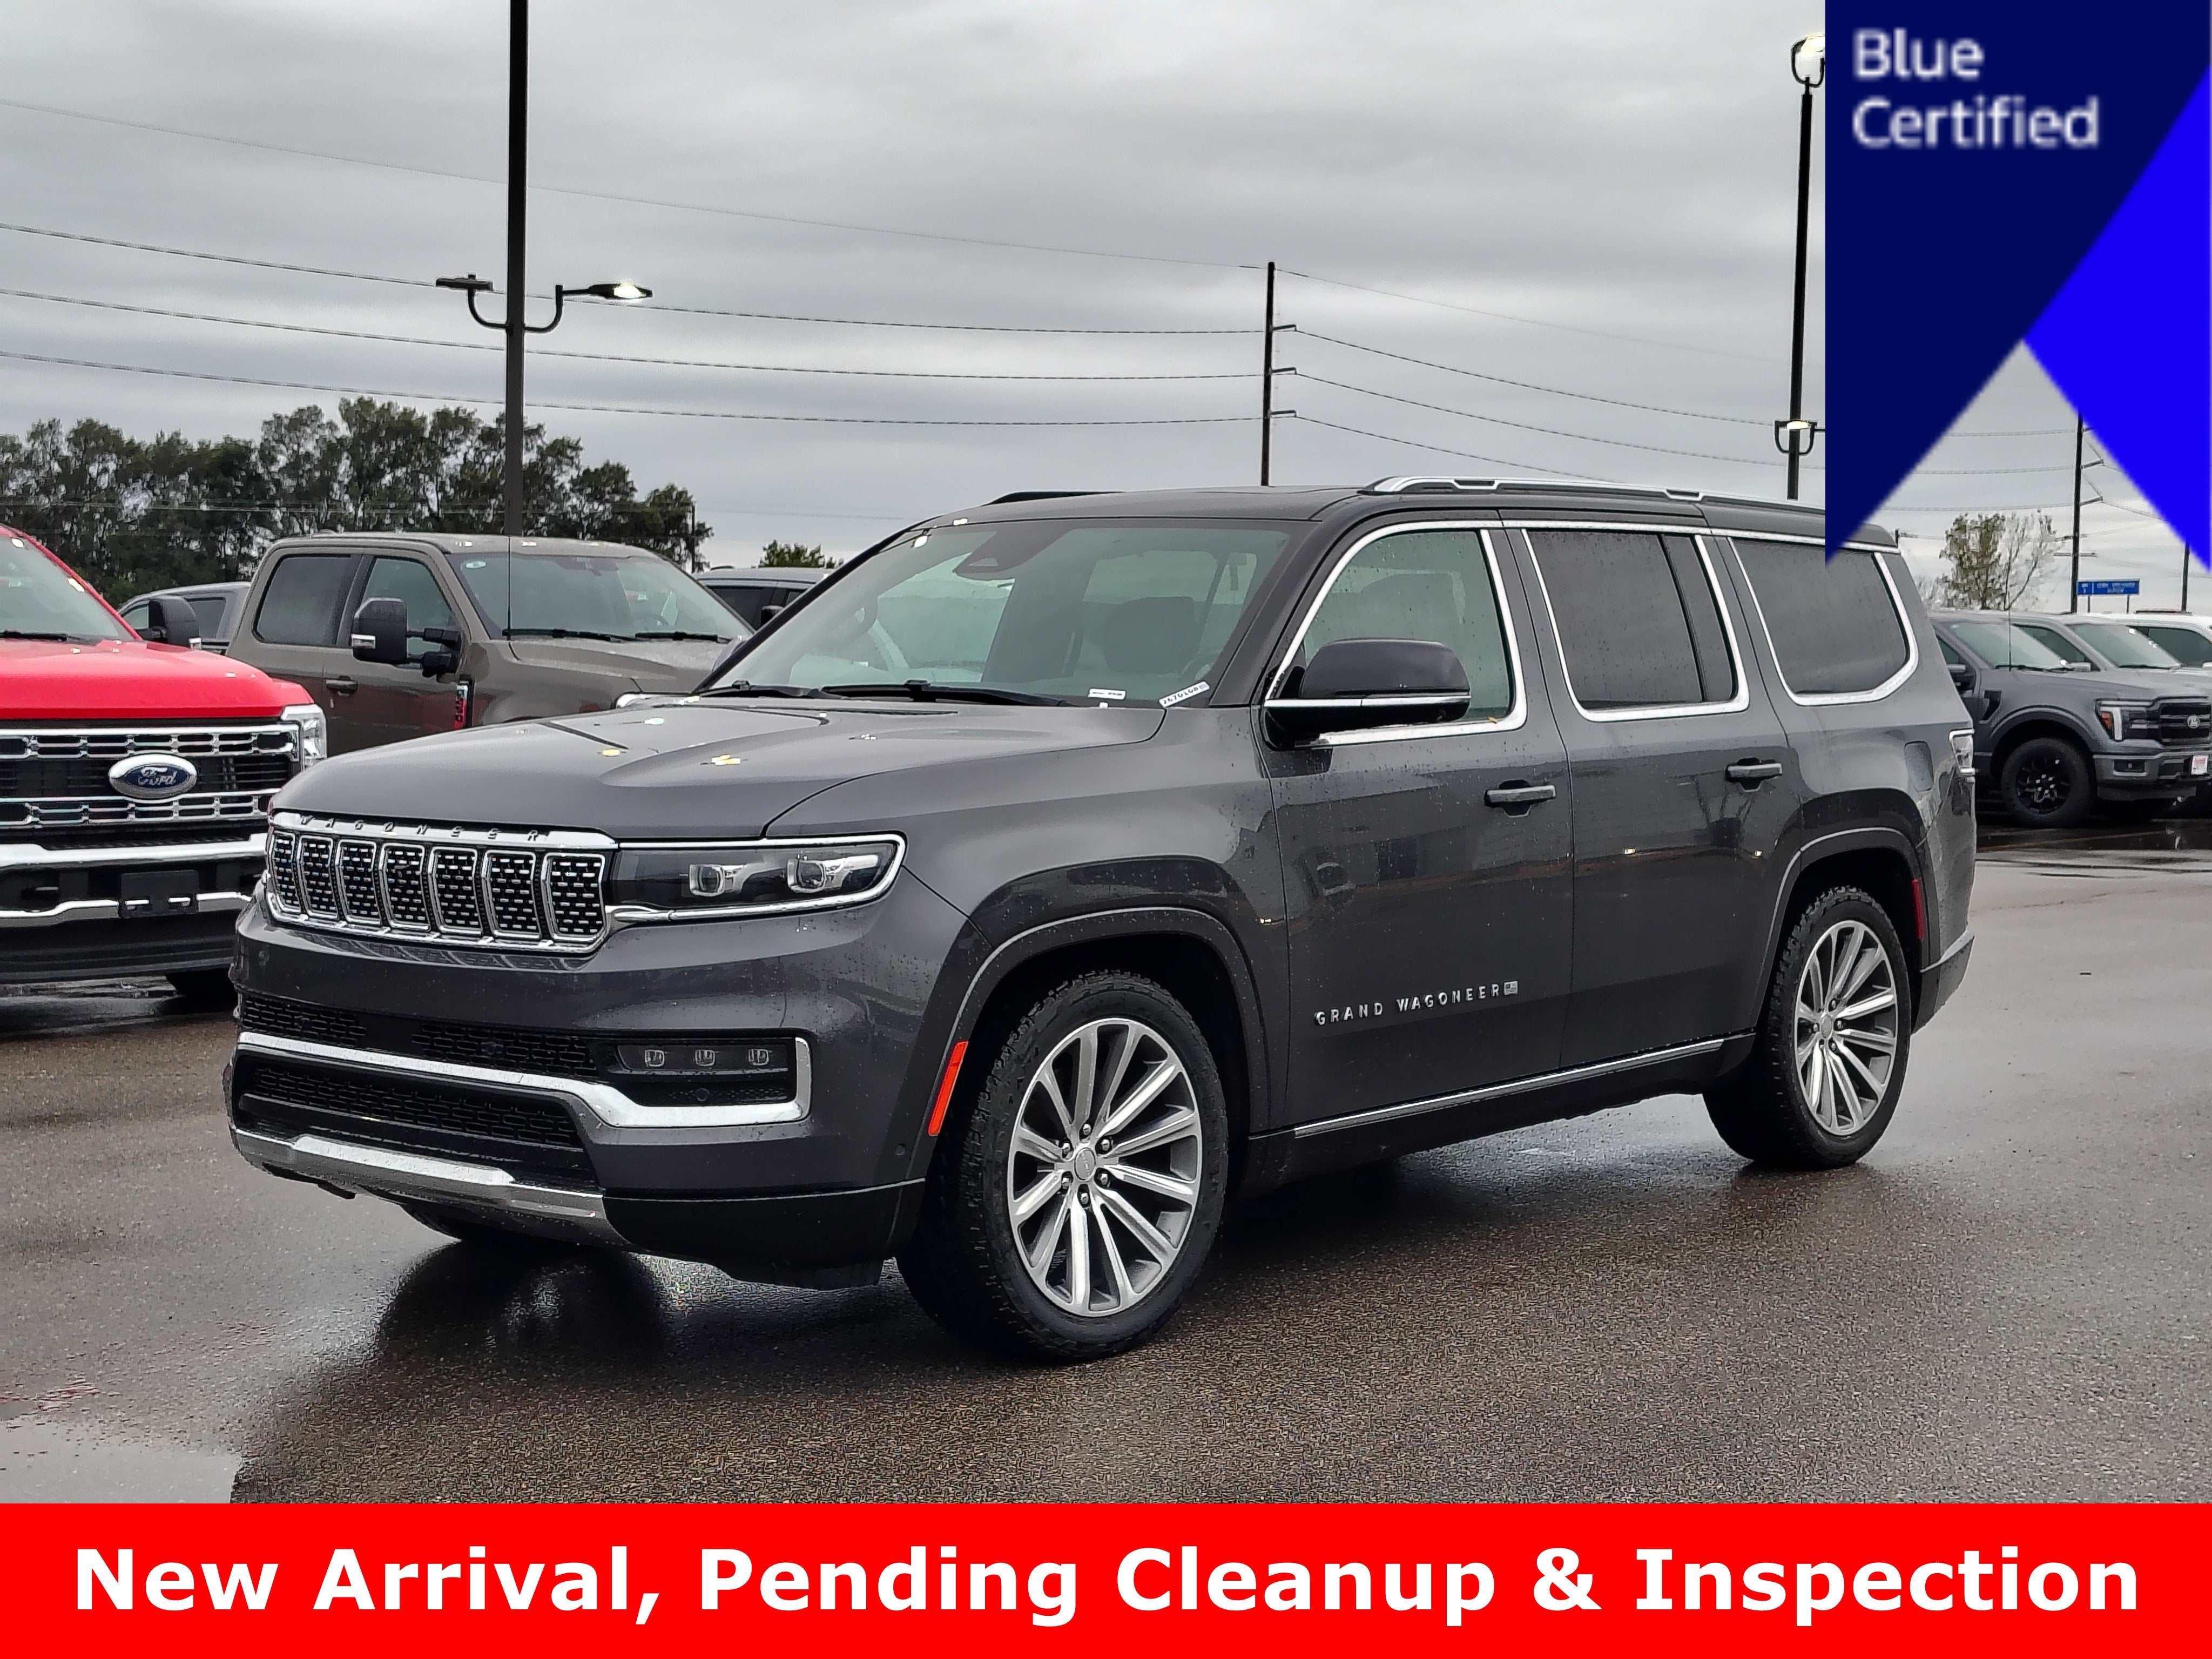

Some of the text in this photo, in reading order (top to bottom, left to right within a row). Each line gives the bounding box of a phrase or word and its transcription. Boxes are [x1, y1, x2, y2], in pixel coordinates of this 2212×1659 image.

[138, 766, 178, 786] Ford
[1314, 1002, 1383, 1026] GRAND
[1397, 983, 1499, 1012] WAGONEER
